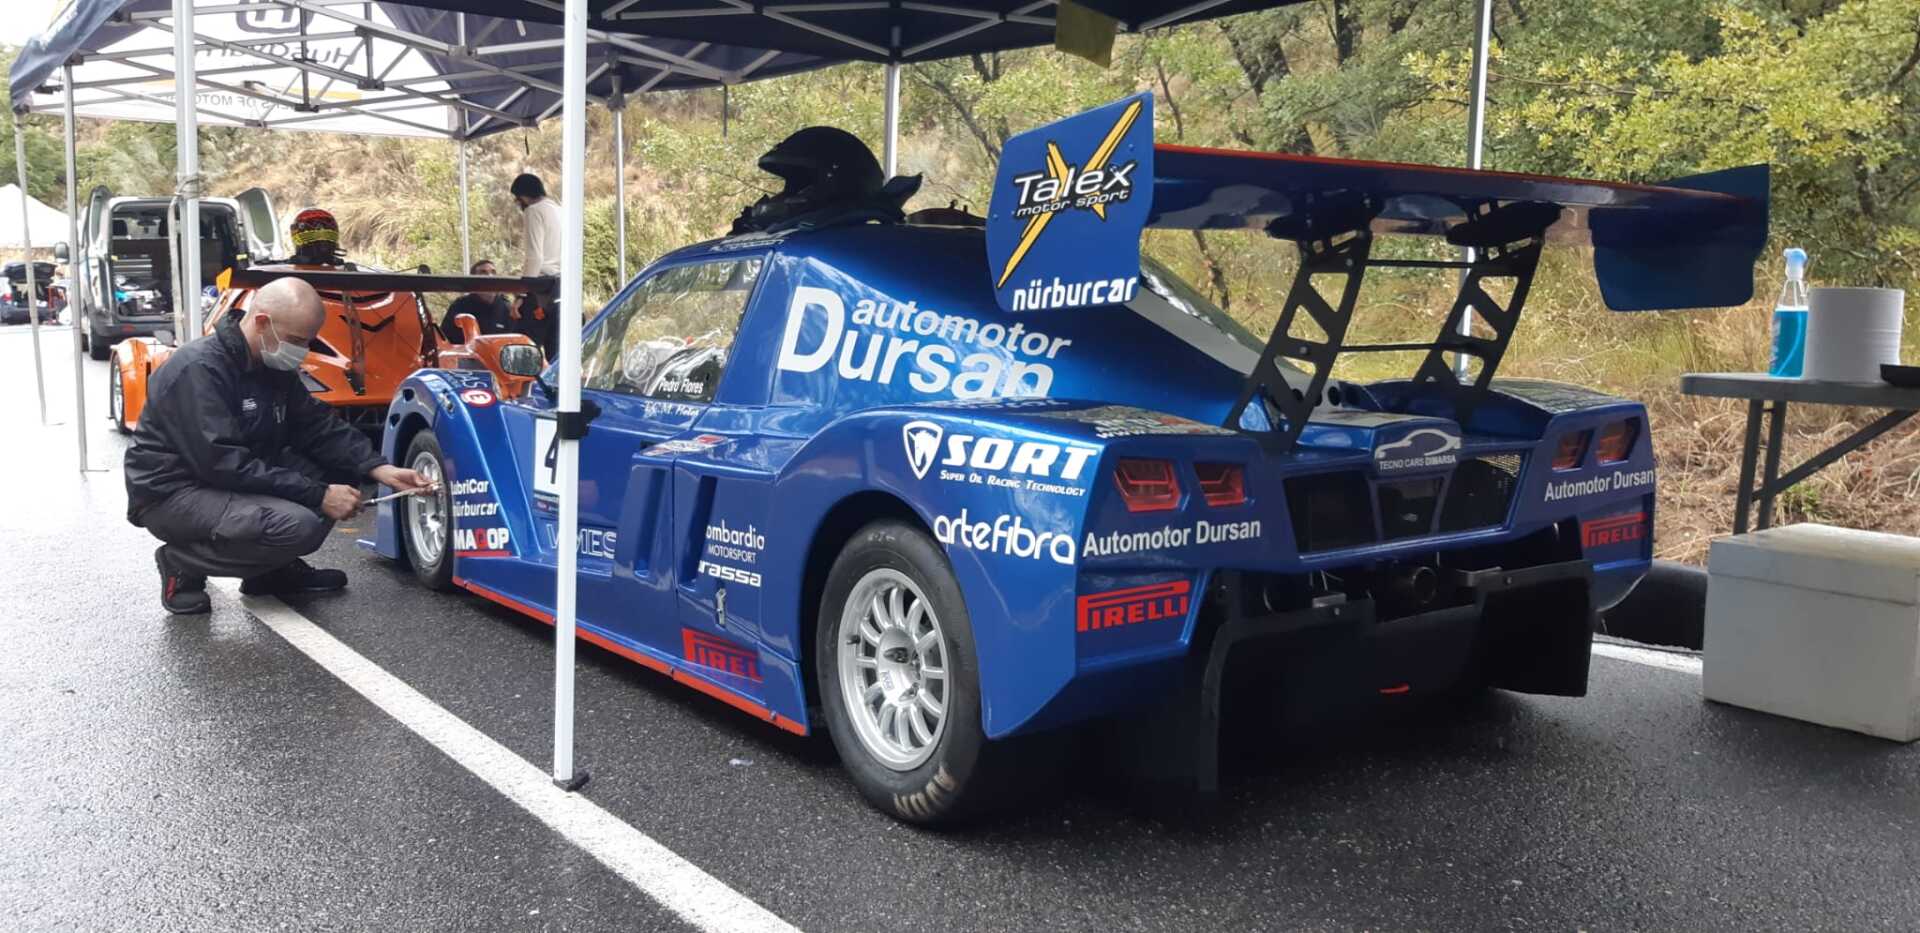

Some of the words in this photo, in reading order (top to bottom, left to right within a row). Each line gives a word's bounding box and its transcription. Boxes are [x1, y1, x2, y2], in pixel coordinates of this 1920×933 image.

[1014, 163, 1135, 205] Talex
[1016, 200, 1070, 217] motor
[1075, 190, 1129, 208] sport
[1012, 277, 1137, 312] nürburcar
[777, 286, 1054, 400] Dursan
[851, 299, 1072, 359] automotor
[681, 378, 704, 394] Flores
[942, 434, 1097, 480] SORT
[1405, 457, 1424, 468] CARS
[1544, 476, 1611, 502] Automotor
[1613, 470, 1654, 490] Dursan
[706, 519, 765, 550] ombardia
[934, 508, 1077, 565] artefibra
[1082, 526, 1191, 557] Automotor
[1196, 520, 1261, 544] Dursan
[707, 543, 757, 563] MOTORSPORT
[1077, 580, 1190, 633] PIRELLI
